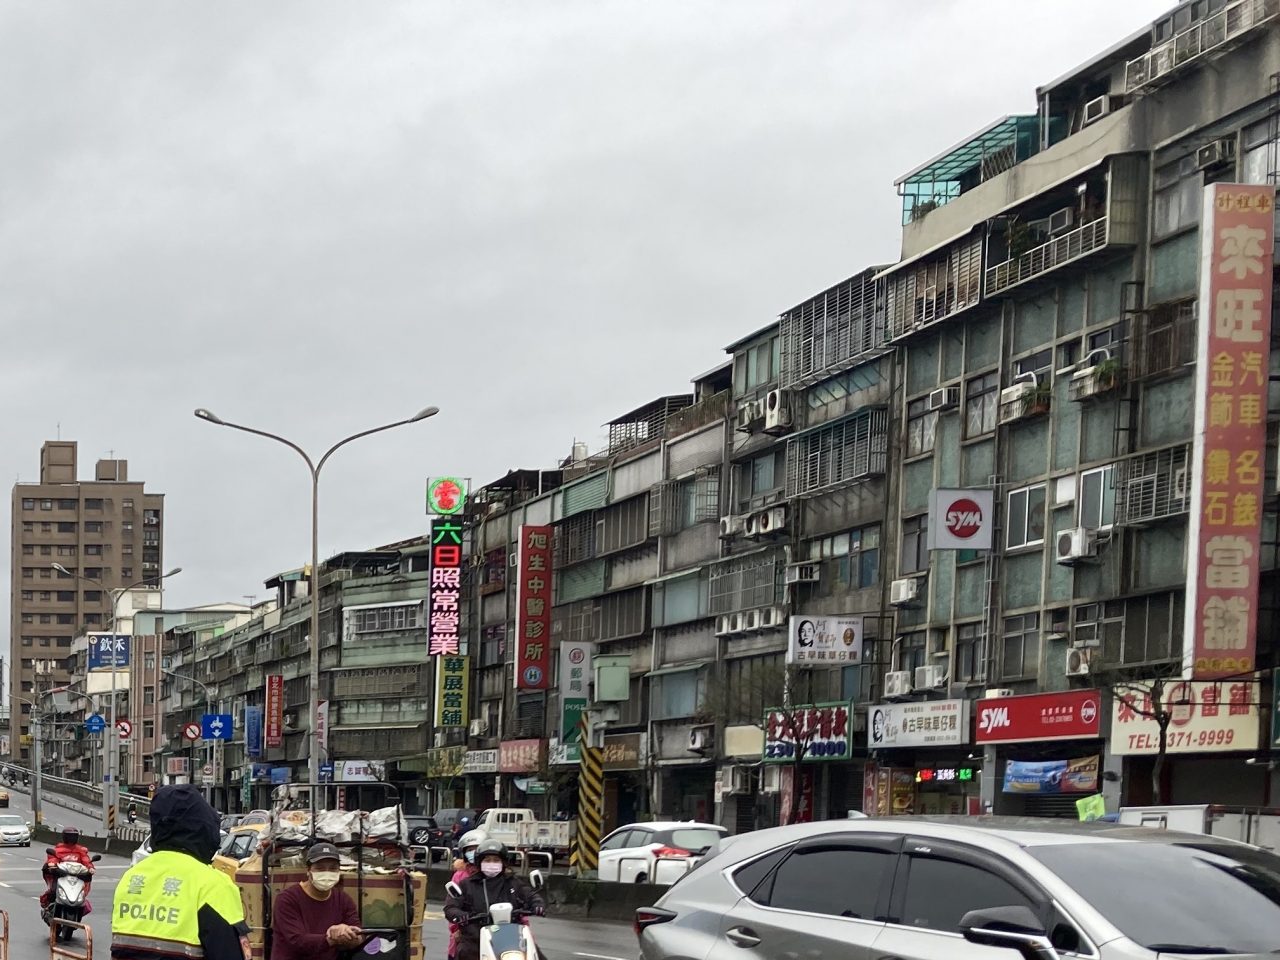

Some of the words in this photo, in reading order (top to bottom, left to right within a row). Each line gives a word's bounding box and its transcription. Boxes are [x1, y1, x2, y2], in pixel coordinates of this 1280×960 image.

[1215, 223, 1266, 343] 來旺
[945, 511, 982, 531] SYM
[430, 522, 462, 656] 六日照常營業
[525, 531, 547, 661] 旭生中醫診所
[979, 707, 1010, 733] SYM
[1128, 728, 1234, 749] TEL:371-9999
[127, 874, 184, 897] 警察
[119, 902, 181, 925] POLICE
